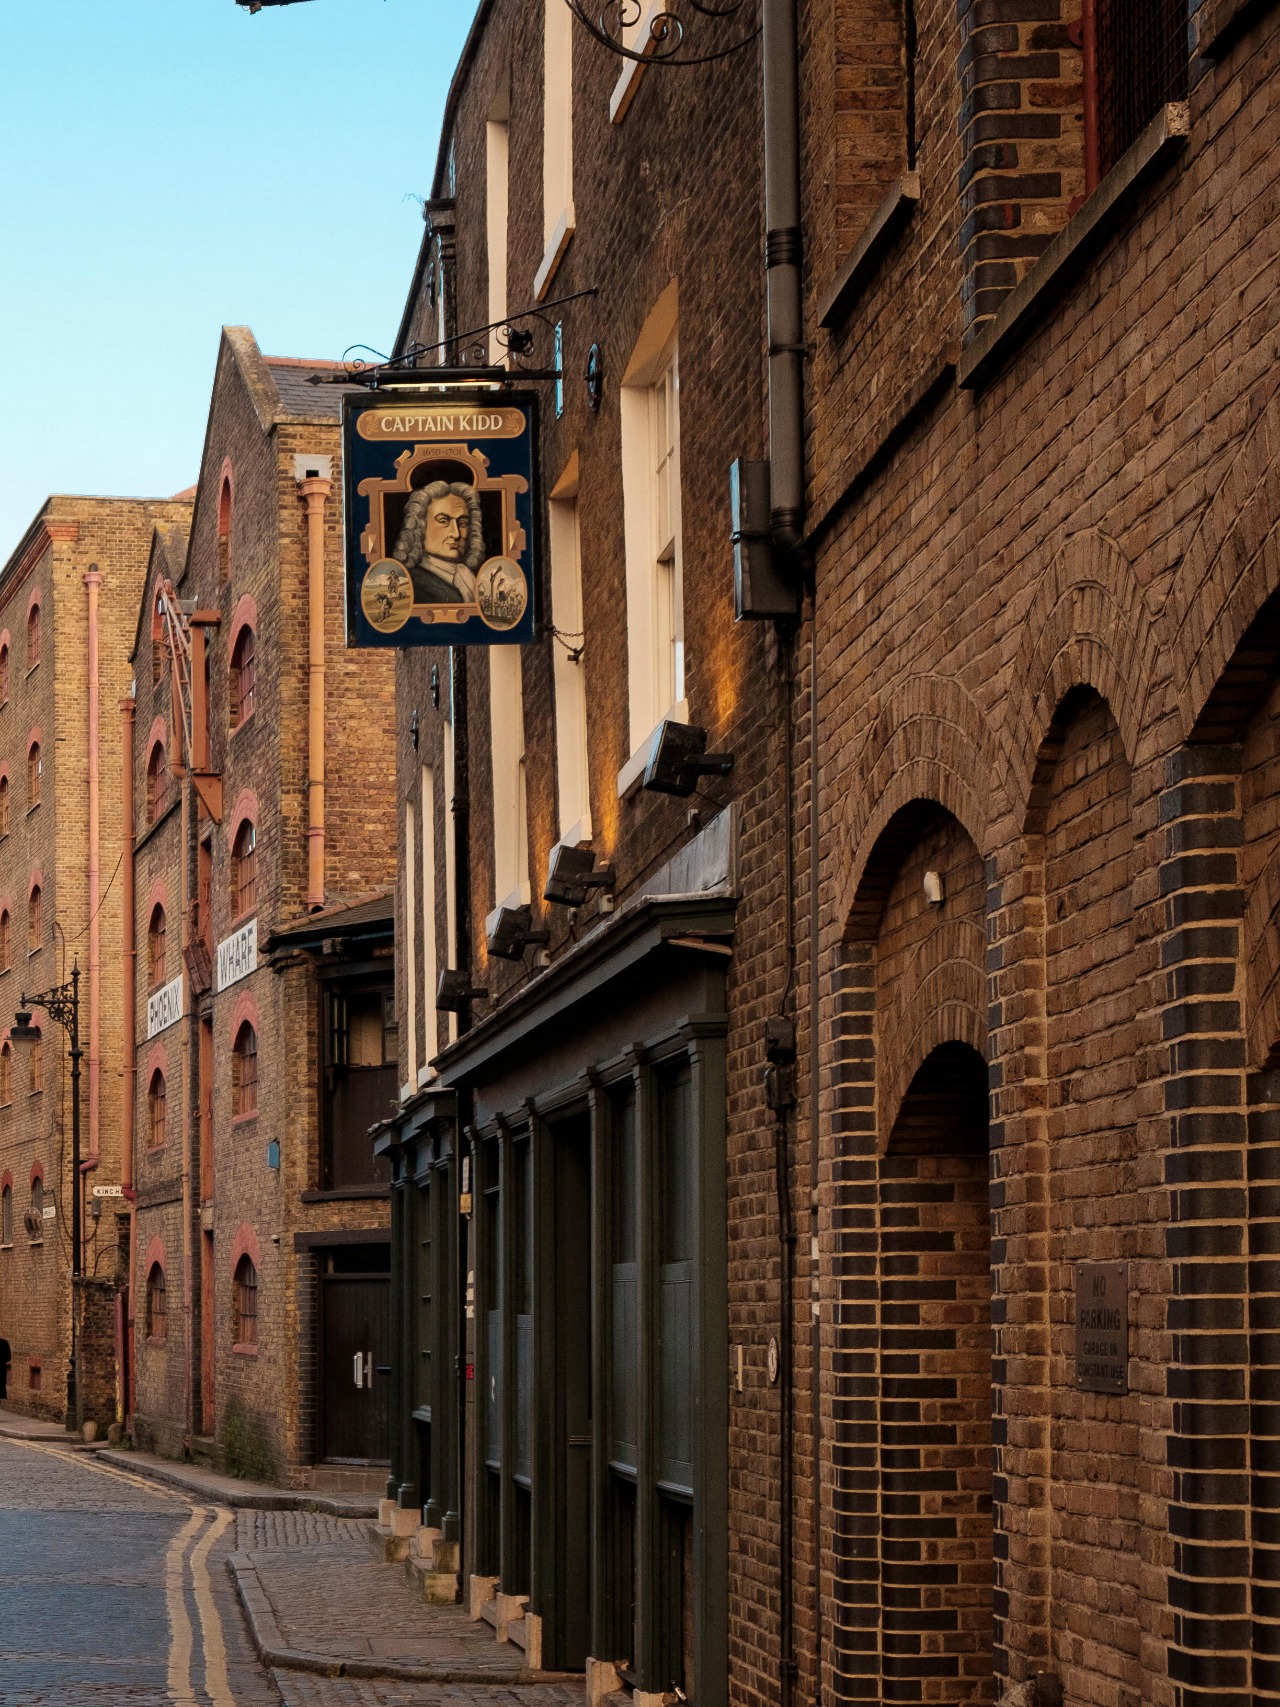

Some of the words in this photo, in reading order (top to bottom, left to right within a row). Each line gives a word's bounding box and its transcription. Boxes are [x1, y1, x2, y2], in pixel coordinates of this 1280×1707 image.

[381, 415, 454, 432] CAPTAIN
[459, 414, 503, 431] KIDD
[422, 448, 463, 457] 1650-1701
[220, 926, 254, 986] WHARF
[149, 981, 181, 1036] PHOENIX
[1092, 1275, 1106, 1298] NO
[1080, 1308, 1121, 1330] PARKING
[1083, 1341, 1108, 1356] GARAGE
[1109, 1342, 1118, 1357] IN
[1078, 1362, 1109, 1379] CONSTANT
[1110, 1364, 1124, 1380] USE
